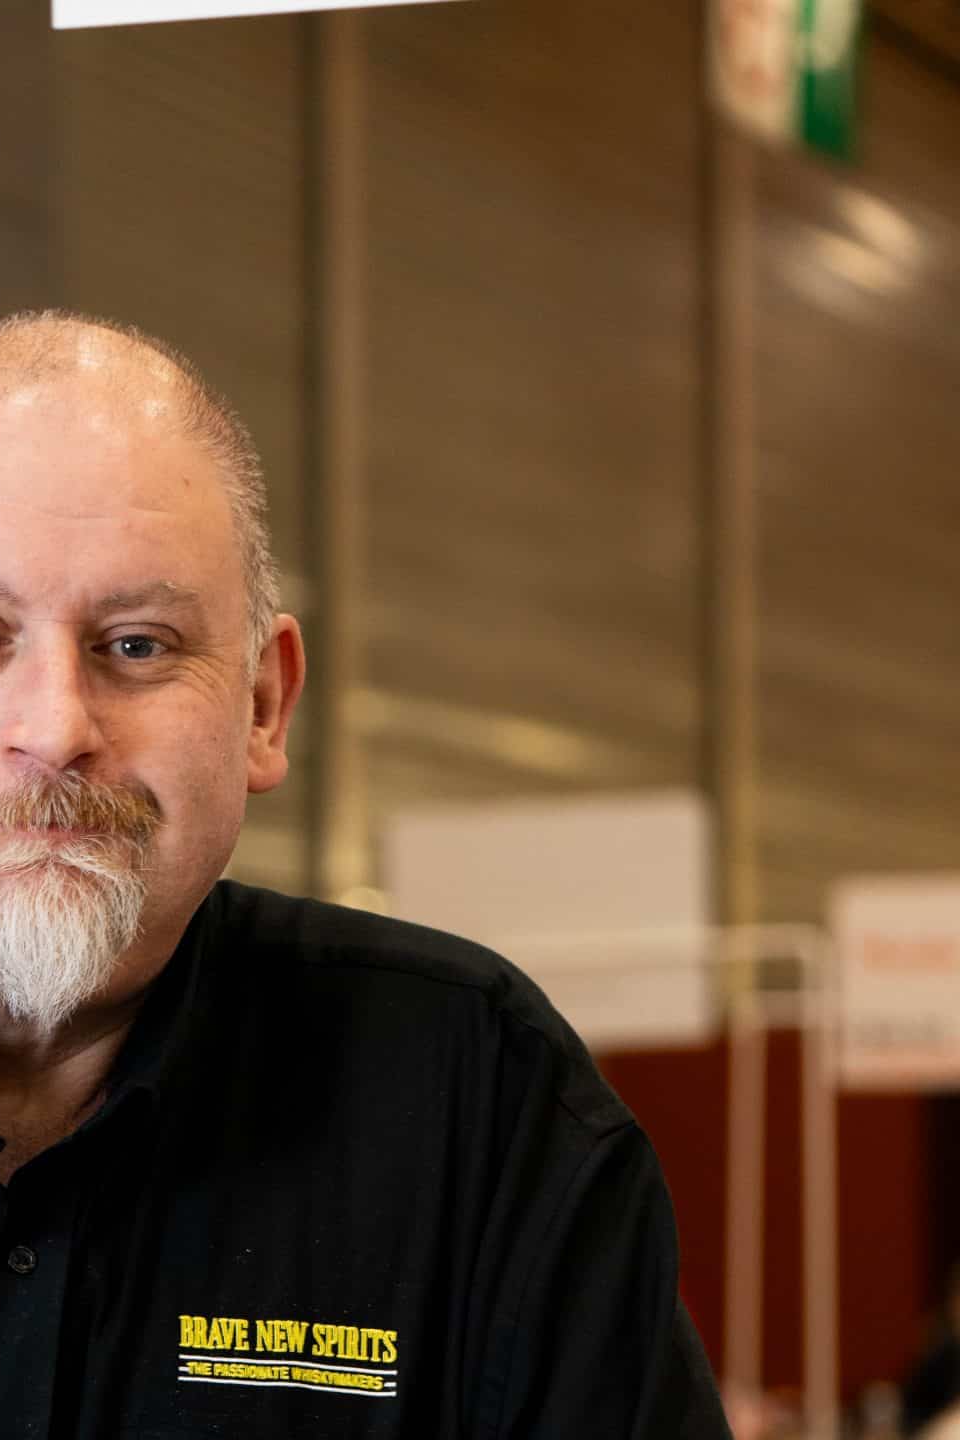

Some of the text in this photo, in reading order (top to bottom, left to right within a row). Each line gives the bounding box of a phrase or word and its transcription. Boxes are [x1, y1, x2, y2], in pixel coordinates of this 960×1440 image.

[178, 1315, 398, 1363] BRAVE NEW SPIRITS
[187, 1361, 384, 1391] THE PASSIONATE WHISKYMAKERS
